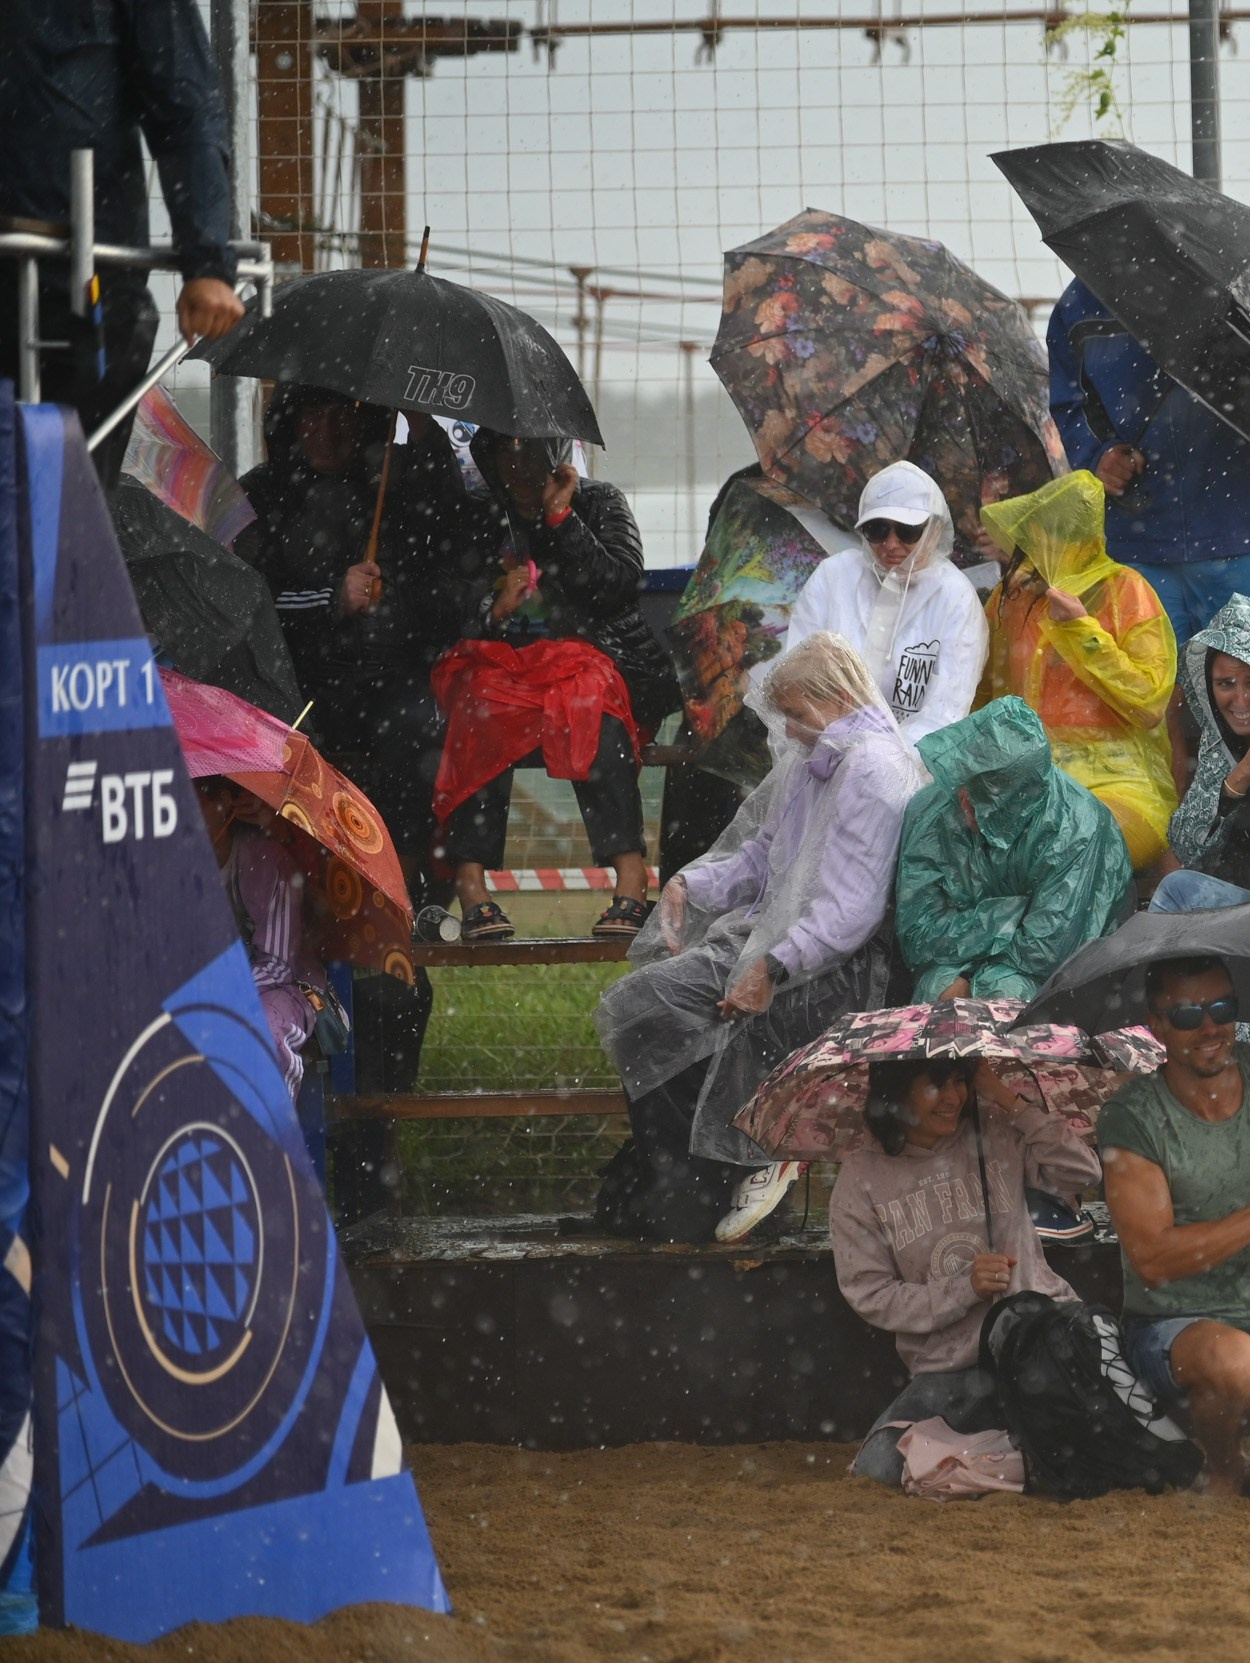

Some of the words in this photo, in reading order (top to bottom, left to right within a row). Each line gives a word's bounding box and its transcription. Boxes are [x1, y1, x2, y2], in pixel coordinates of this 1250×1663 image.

[52, 660, 130, 713] КОРТ
[141, 659, 154, 705] 1
[898, 655, 937, 685] FUNN
[101, 768, 178, 844] ВТБ
[918, 1176, 935, 1187] EST.
